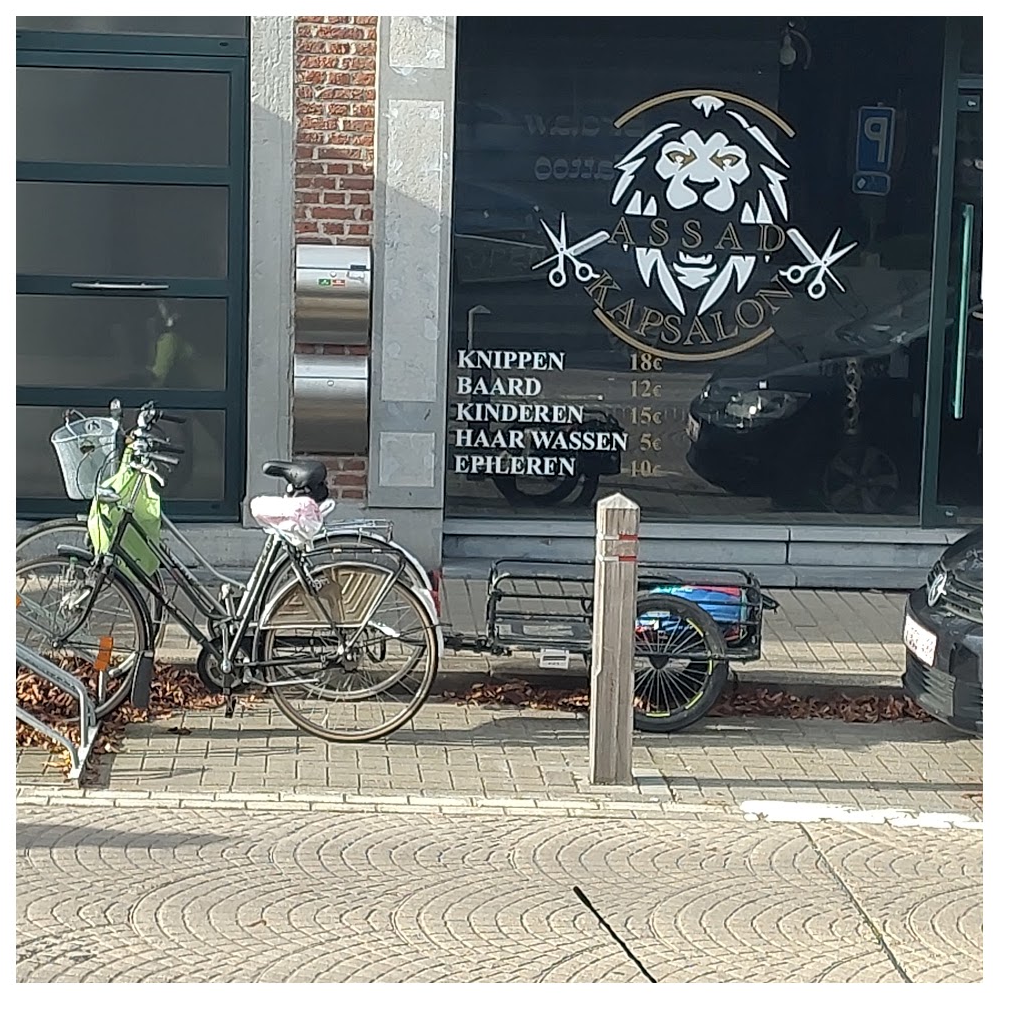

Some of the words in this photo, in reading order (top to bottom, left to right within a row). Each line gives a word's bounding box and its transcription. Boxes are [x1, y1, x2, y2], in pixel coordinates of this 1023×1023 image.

[607, 216, 787, 252] ASSAD
[583, 268, 794, 347] KAPSALON
[457, 349, 566, 372] KNIPPEN
[630, 353, 663, 371] 18€
[456, 376, 542, 397] BAARD
[630, 380, 662, 398] 12€
[455, 402, 585, 424] KINDEREN
[630, 407, 662, 425] 15€
[455, 429, 526, 449] HAAR
[530, 431, 629, 452] WASSEN
[640, 433, 662, 451] 5€
[453, 454, 577, 477] EPILEREN
